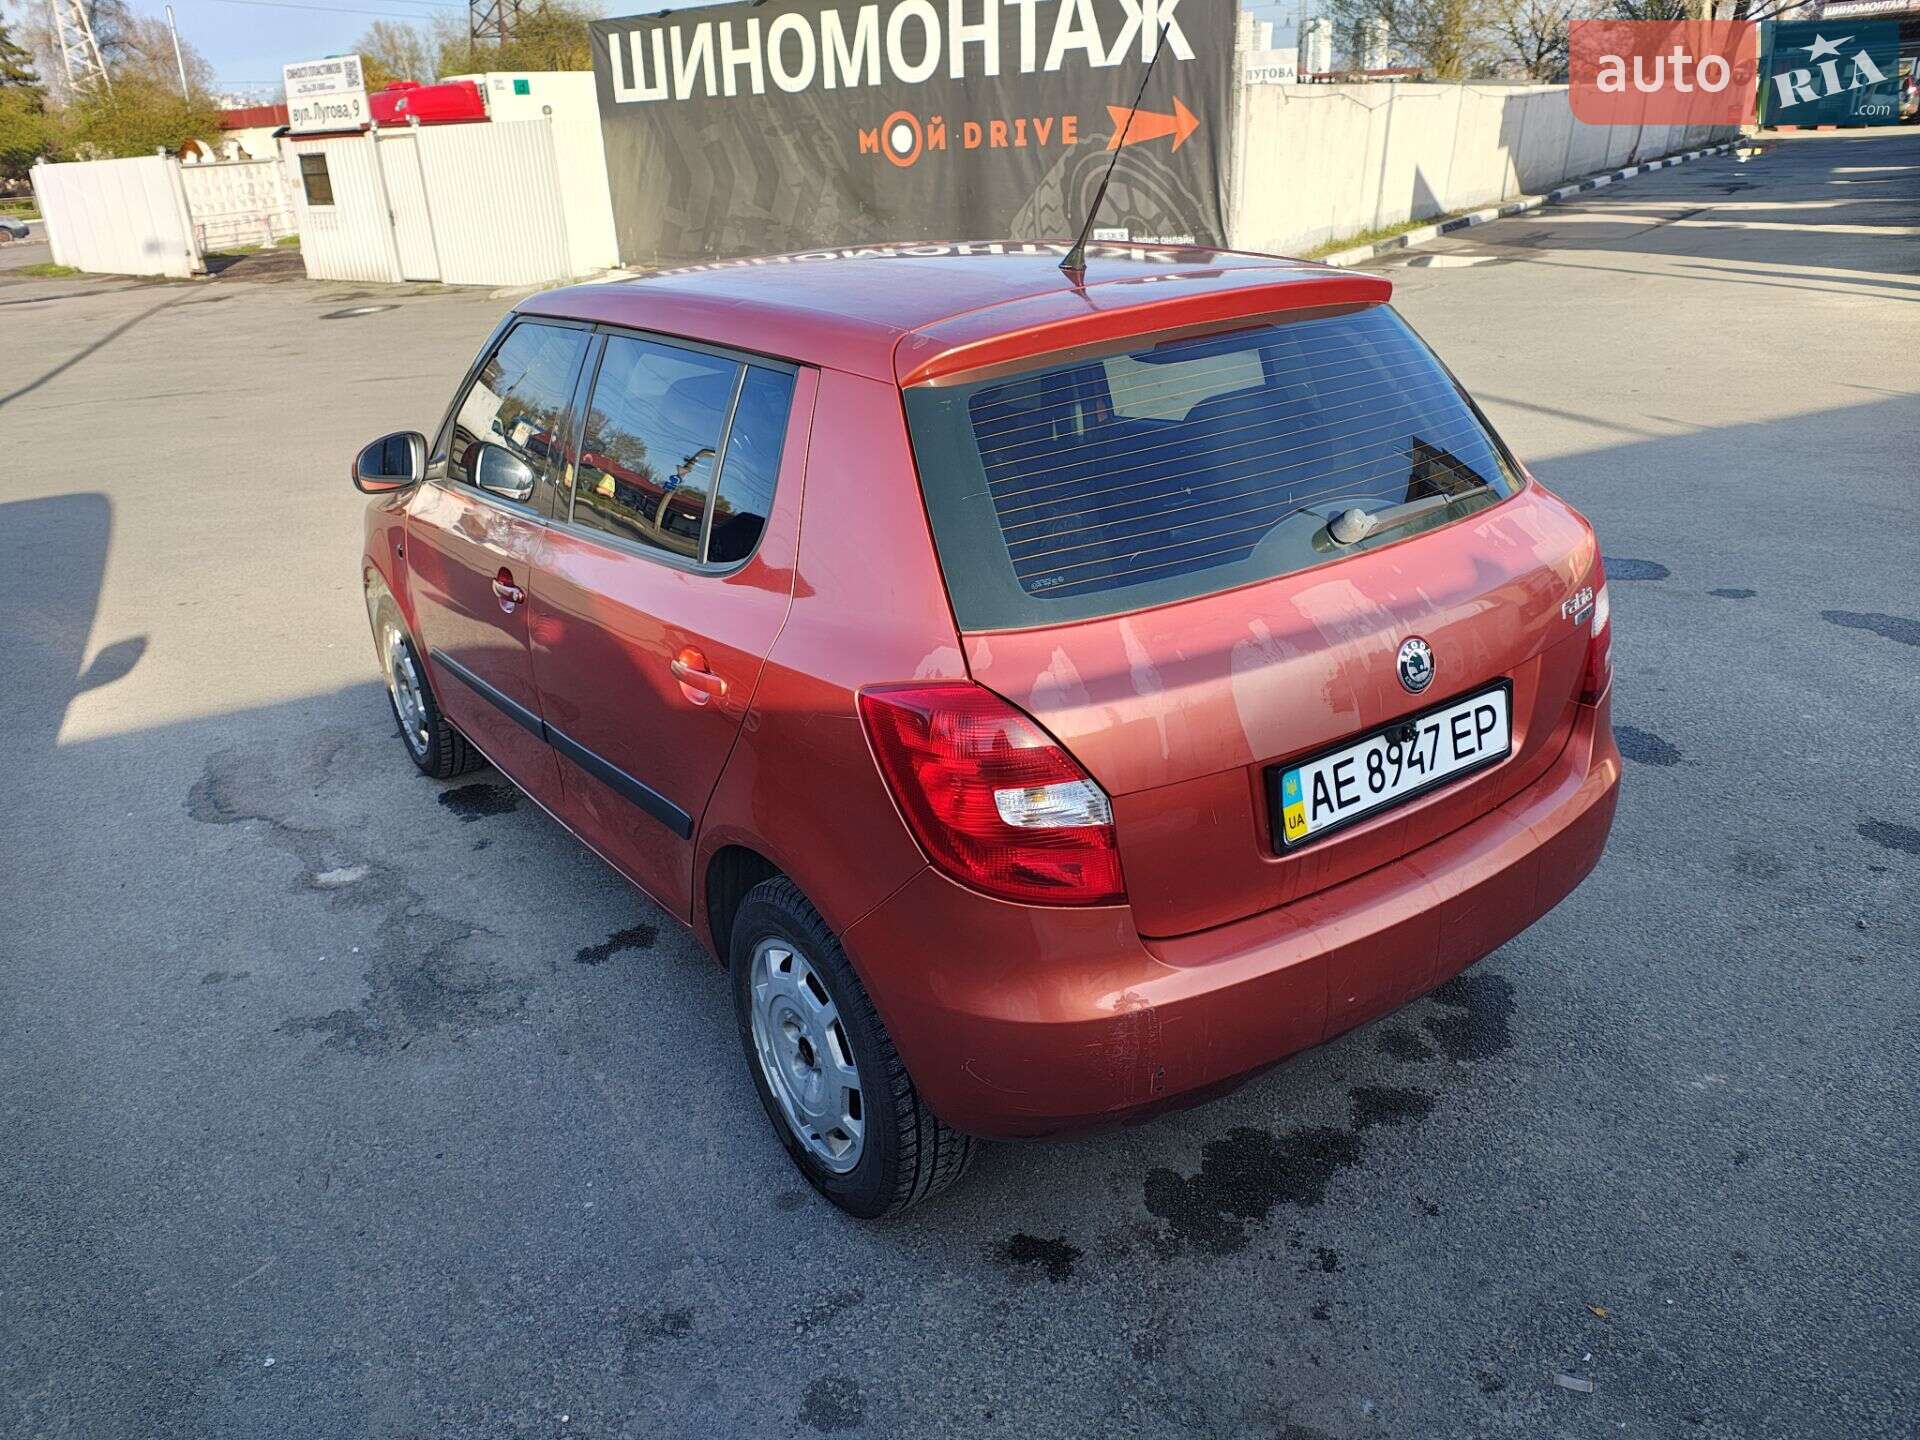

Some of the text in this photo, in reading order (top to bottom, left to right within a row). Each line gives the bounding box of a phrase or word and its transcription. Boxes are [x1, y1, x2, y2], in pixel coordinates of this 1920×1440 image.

[608, 0, 1196, 103] ШИНОМОНТАЖ
[352, 98, 360, 117] 9
[963, 115, 1079, 149] DRIVE
[1311, 704, 1497, 822] AE 8947 EP
[1288, 813, 1305, 829] UA
